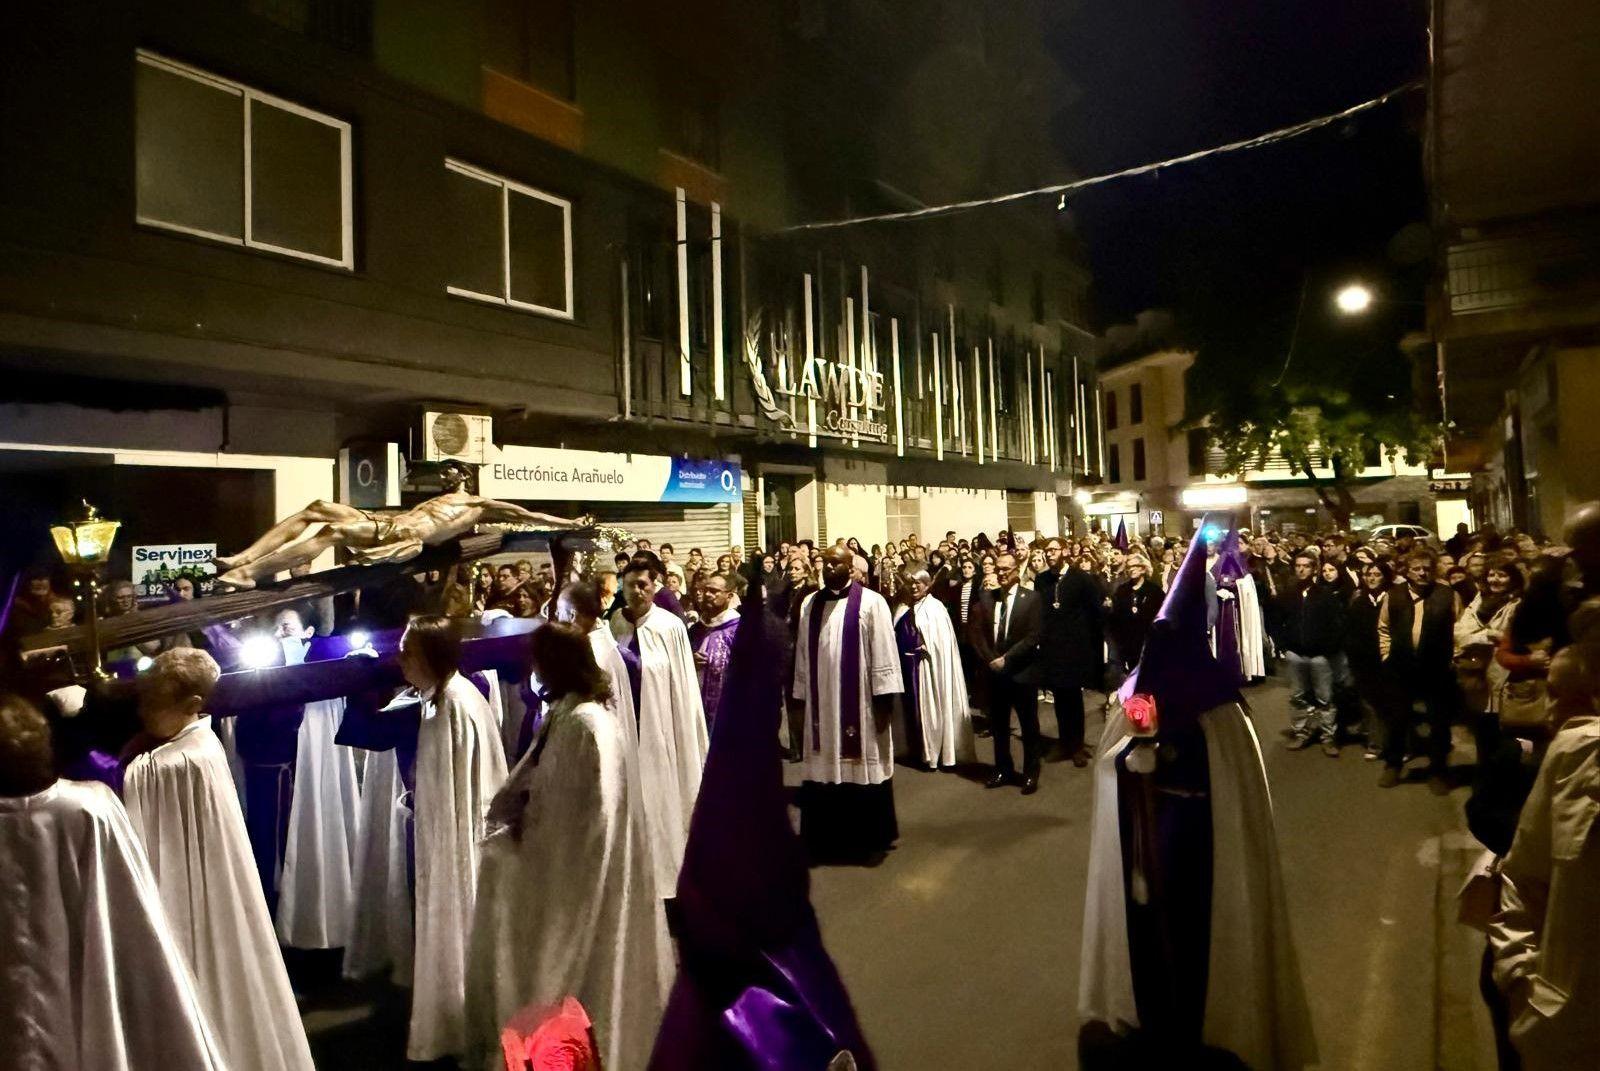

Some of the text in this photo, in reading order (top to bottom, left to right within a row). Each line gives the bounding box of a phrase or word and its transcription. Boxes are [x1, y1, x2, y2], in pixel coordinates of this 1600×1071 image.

[493, 463, 624, 484] Electrónica Arañuelo
[720, 469, 737, 495] O2
[135, 546, 213, 565] Servinex
